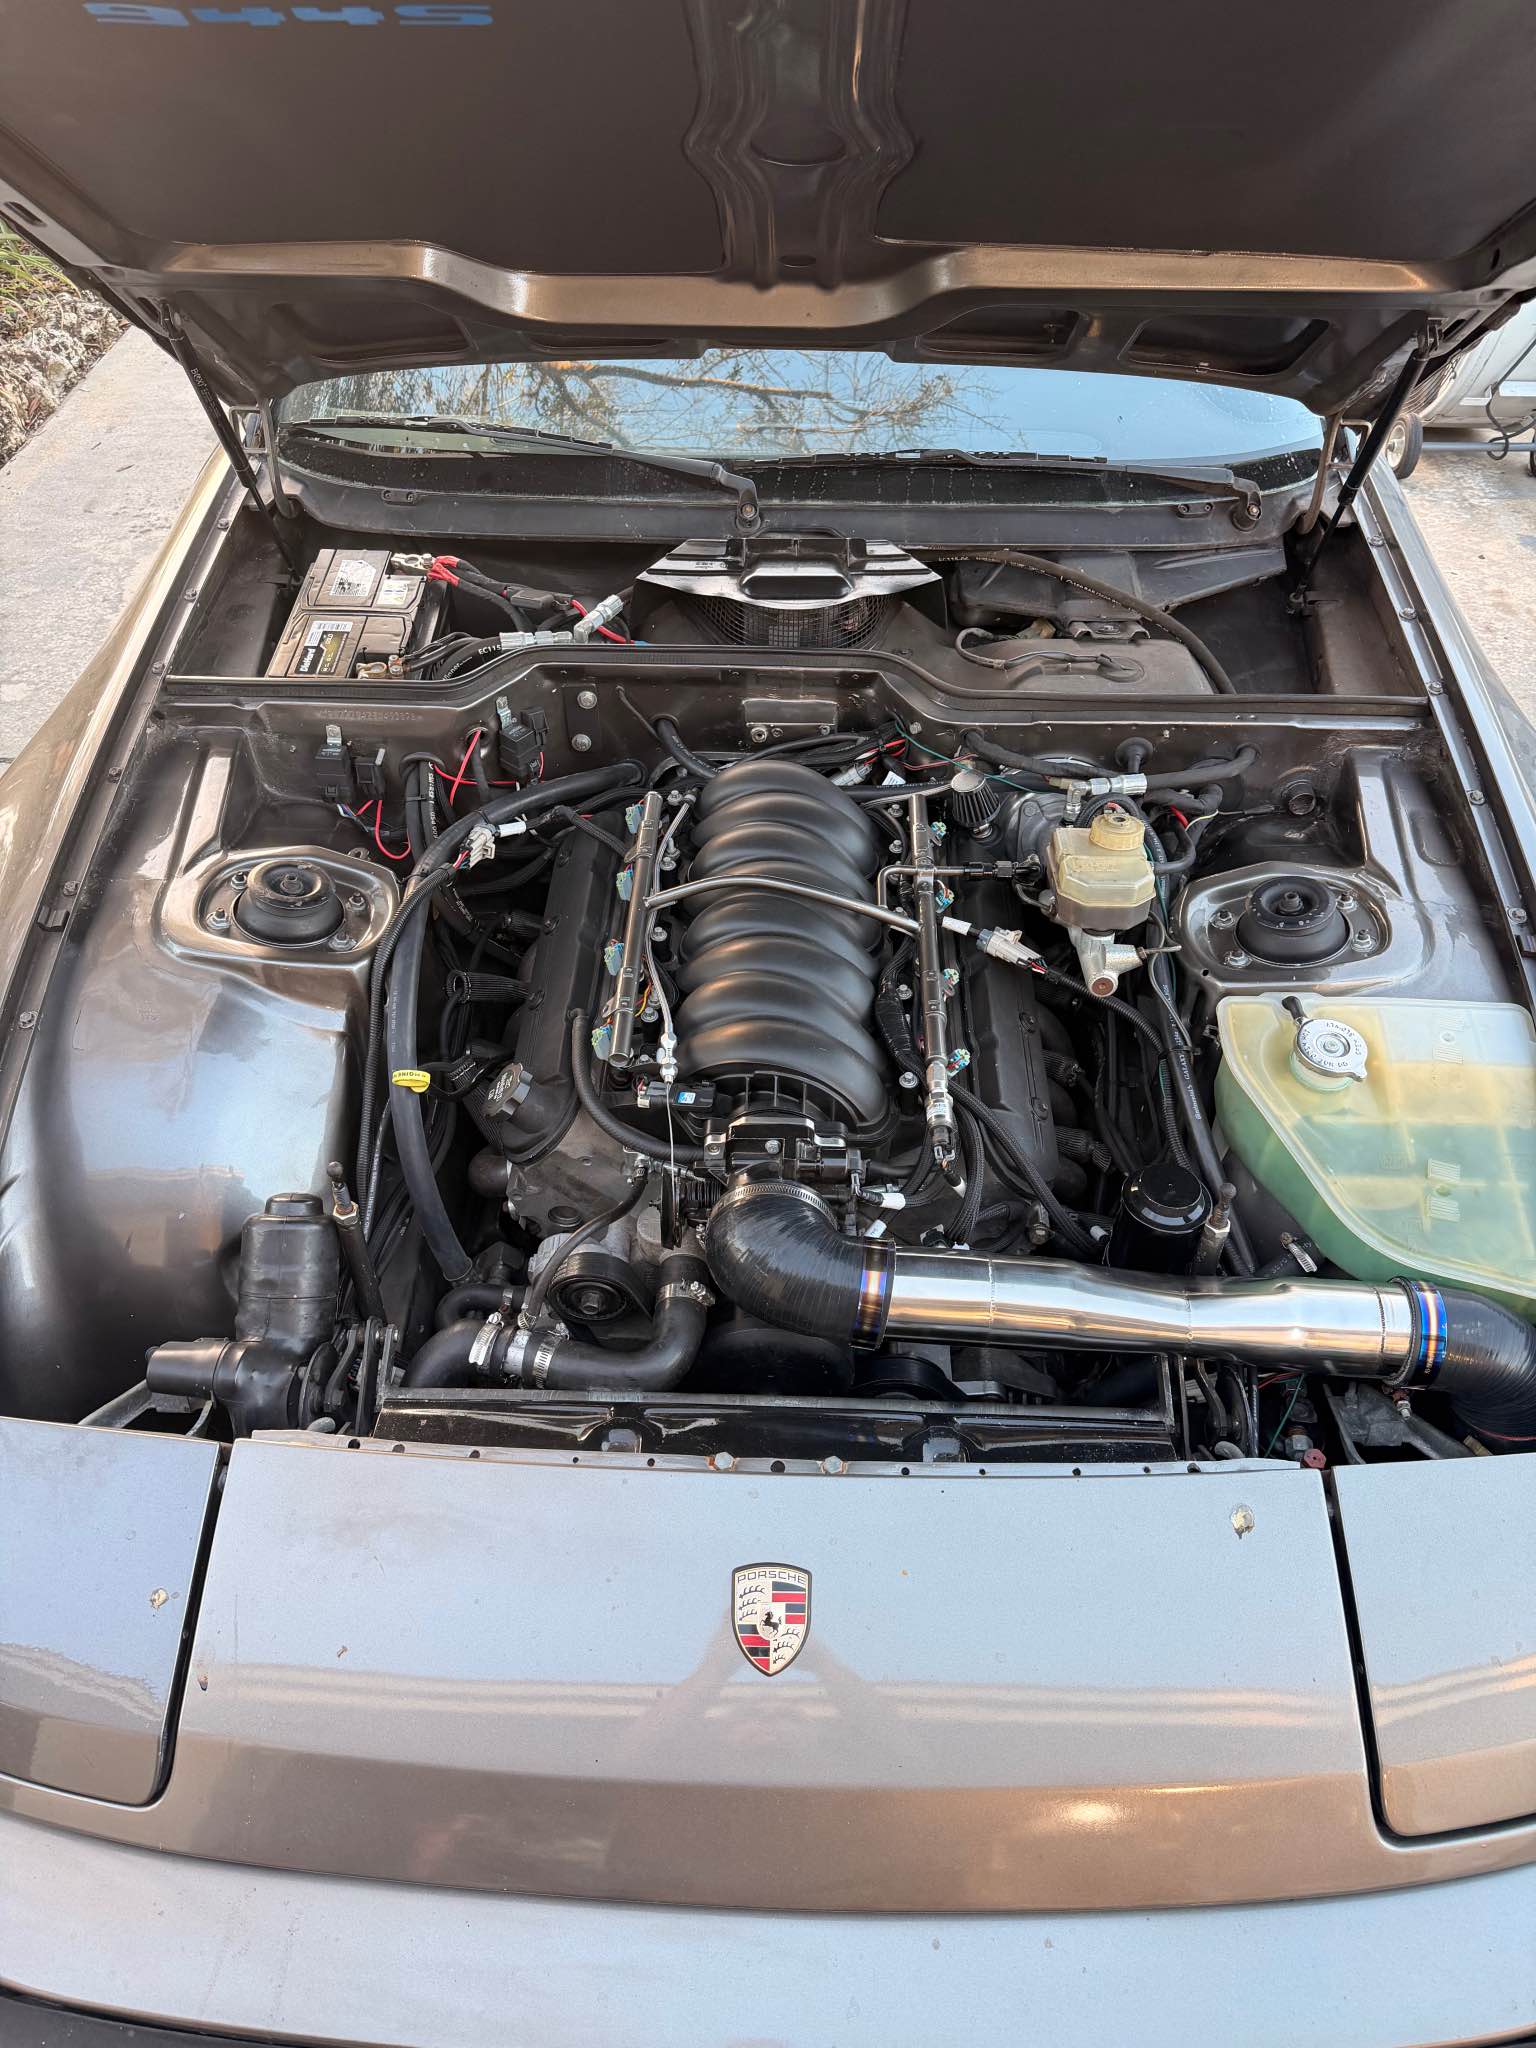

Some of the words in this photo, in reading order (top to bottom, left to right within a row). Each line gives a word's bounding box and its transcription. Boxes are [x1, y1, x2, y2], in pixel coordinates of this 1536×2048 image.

[82, 2, 494, 27] 944S
[299, 648, 316, 672] DieHard
[737, 1570, 807, 1585] PORSCHE
